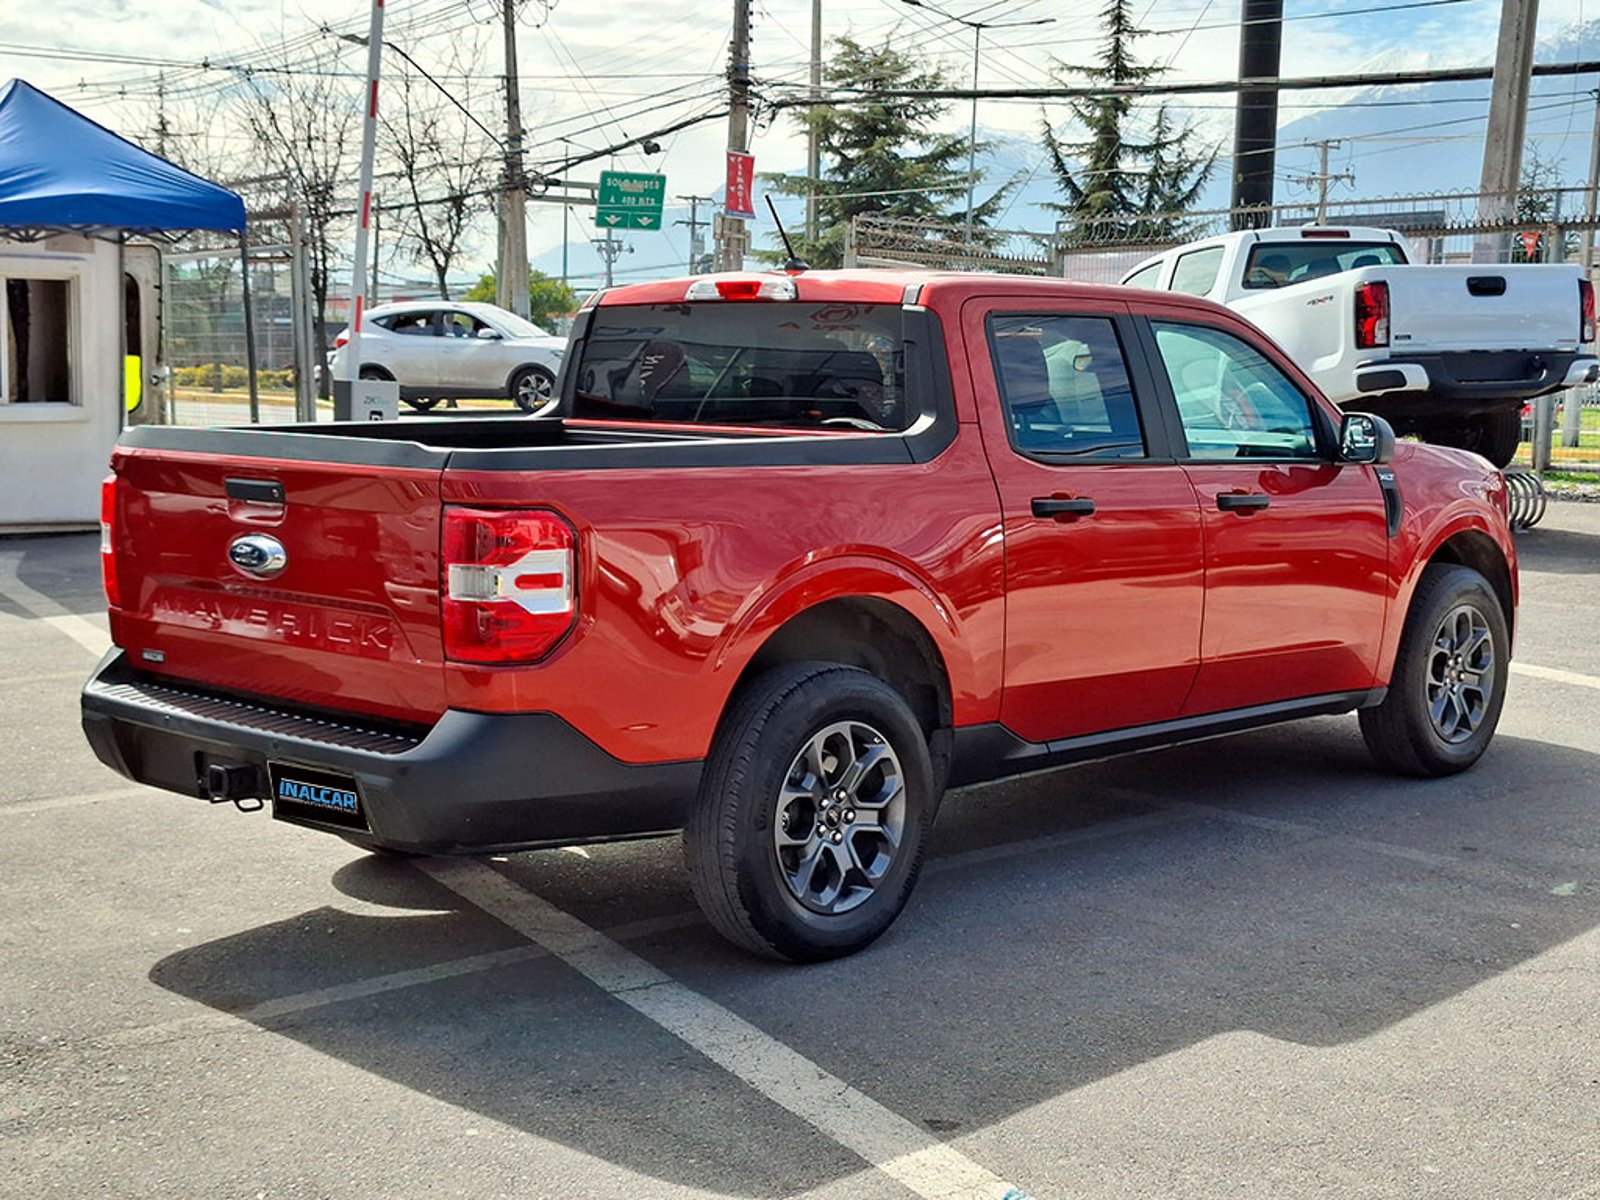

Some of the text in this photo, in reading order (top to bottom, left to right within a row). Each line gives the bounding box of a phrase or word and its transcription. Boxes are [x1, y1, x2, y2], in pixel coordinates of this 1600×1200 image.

[632, 179, 660, 190] BSES
[152, 600, 388, 650] MAVERICK
[279, 780, 355, 809] INALCAR
